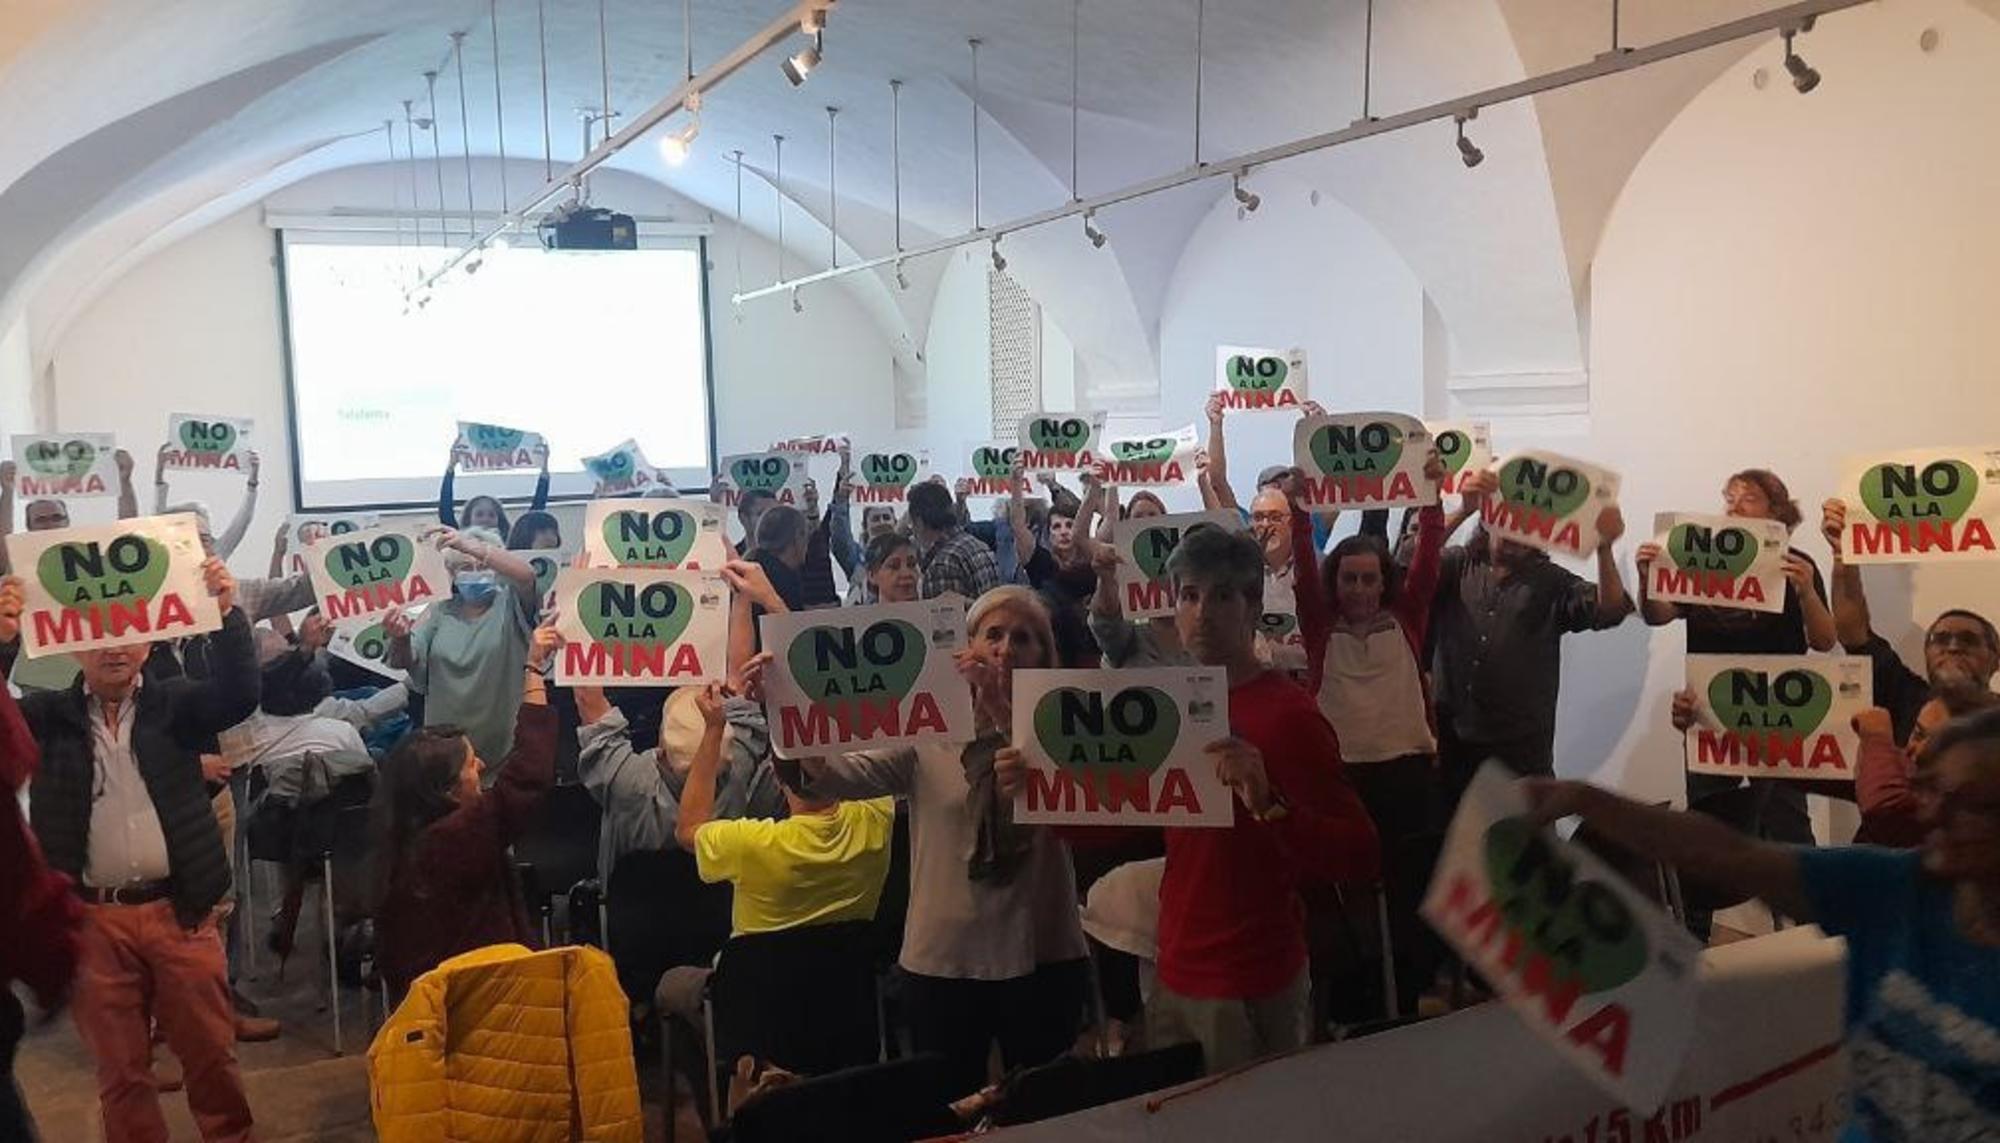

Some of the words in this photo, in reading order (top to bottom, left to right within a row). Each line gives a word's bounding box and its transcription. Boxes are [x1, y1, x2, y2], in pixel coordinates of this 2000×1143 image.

[1237, 356, 1278, 377] NO
[1240, 380, 1248, 389] A
[1252, 380, 1268, 389] LA
[1220, 389, 1298, 409] MINA
[189, 420, 228, 440] NO
[1041, 420, 1081, 438] NO
[1328, 422, 1390, 455] NO
[38, 440, 86, 461] NO
[1055, 440, 1071, 449] LA
[1123, 439, 1168, 453] NO
[168, 450, 241, 470] MINA
[742, 458, 781, 476] NO
[872, 454, 910, 473] NO
[1023, 450, 1093, 468] MINA
[1333, 460, 1345, 473] A
[1353, 458, 1376, 472] LA
[875, 475, 882, 483] A
[1104, 461, 1185, 482] MINA
[1516, 459, 1578, 496] NO
[1881, 461, 1960, 499] NO
[21, 474, 106, 496] MINA
[857, 486, 904, 502] MIN
[1303, 472, 1417, 505] MINA
[726, 488, 795, 507] MA
[1889, 503, 1901, 518] A
[1912, 502, 1942, 517] LA
[620, 511, 683, 542] NO
[1481, 492, 1581, 551] MINA
[1684, 525, 1745, 556] NO
[1852, 518, 1997, 555] MINA
[60, 534, 150, 582] NO
[340, 536, 400, 572] NO
[626, 547, 639, 560] A
[644, 546, 668, 560] LA
[1686, 557, 1698, 570] A
[1705, 558, 1728, 570] LA
[351, 573, 364, 586] A
[368, 567, 393, 582] LA
[1656, 567, 1766, 603] MINA
[74, 586, 91, 602] A
[100, 580, 135, 599] LA
[325, 574, 433, 620] MINA
[600, 583, 678, 619] NO
[33, 592, 195, 648] MINA
[603, 622, 619, 638] A
[628, 623, 657, 638] LA
[814, 622, 905, 672] NO
[565, 642, 703, 677] MINA
[824, 678, 842, 697] A
[852, 673, 887, 693] LA
[1732, 670, 1813, 707] NO
[780, 692, 948, 748] MINA
[1060, 688, 1158, 737] NO
[1737, 712, 1753, 728] A
[1763, 712, 1793, 728] LA
[1069, 744, 1088, 763] A
[1100, 744, 1137, 763] LA
[1698, 729, 1847, 769] MINA
[1026, 767, 1203, 814] MINA
